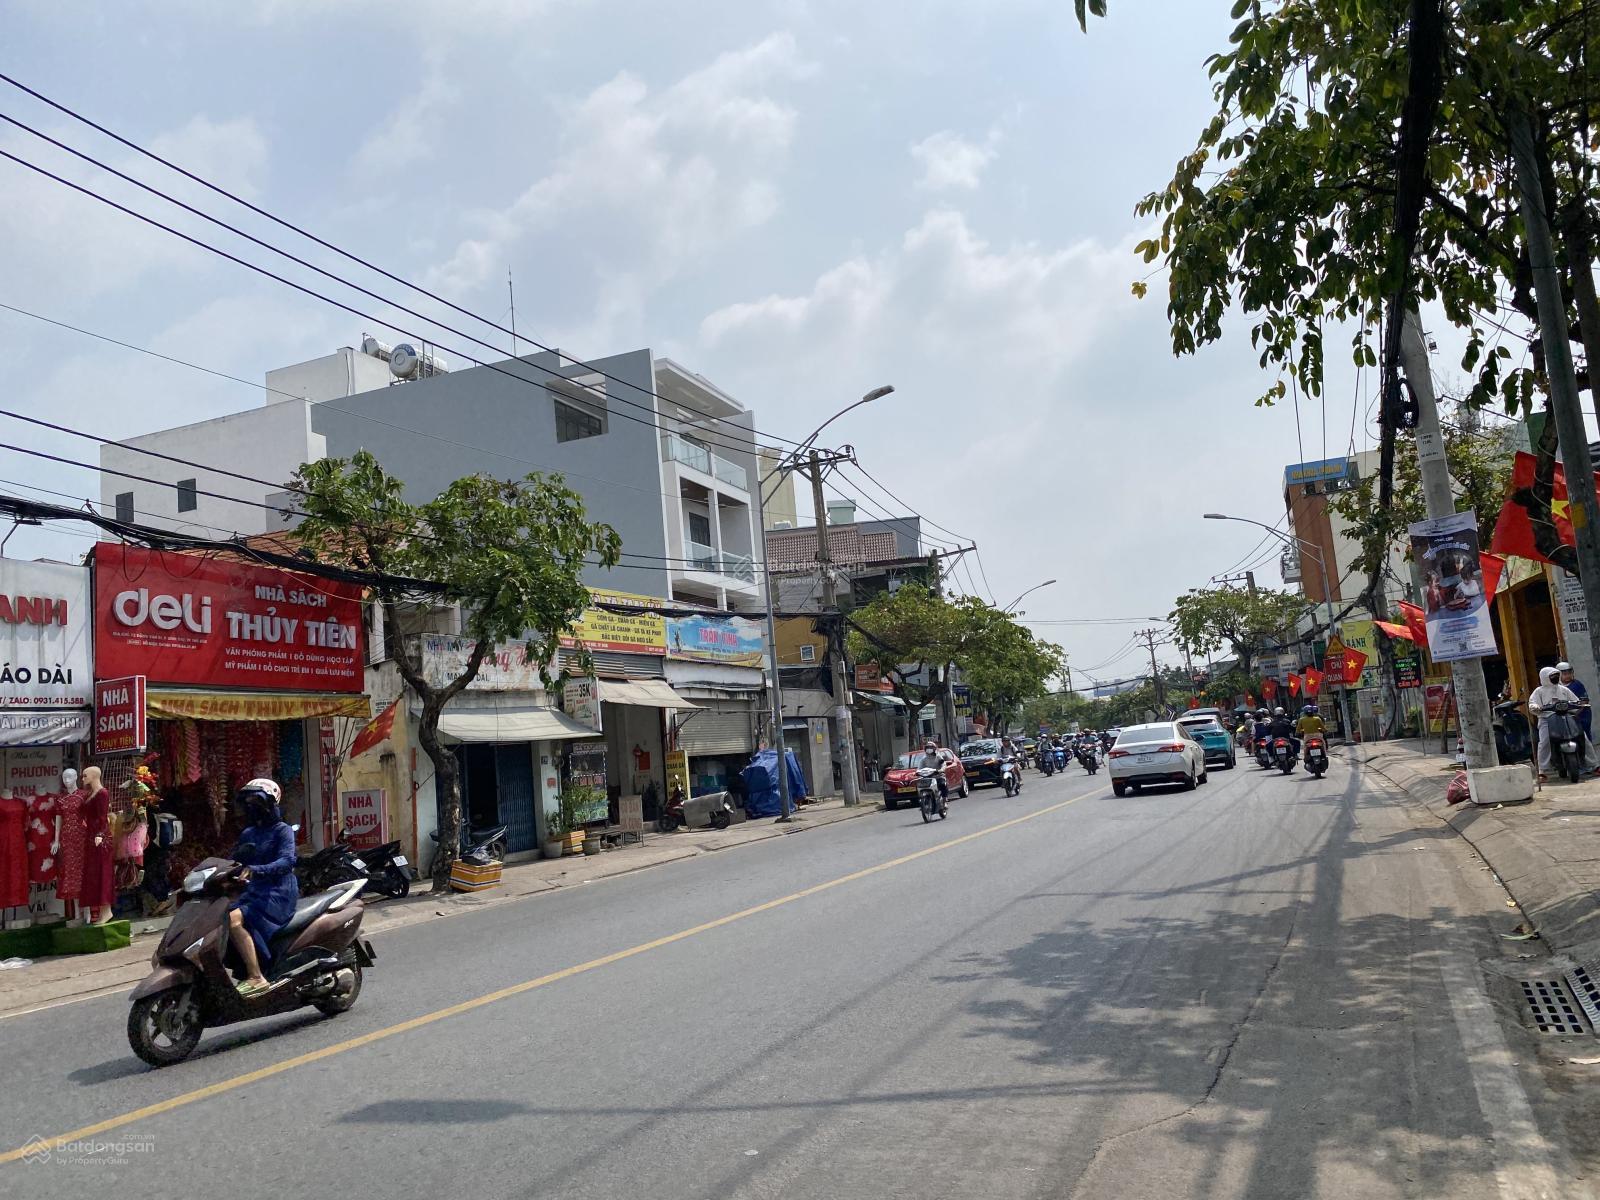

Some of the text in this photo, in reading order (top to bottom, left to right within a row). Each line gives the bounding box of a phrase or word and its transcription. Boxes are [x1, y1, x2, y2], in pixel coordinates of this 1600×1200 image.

[255, 585, 327, 607] NHÀ SÁCH
[113, 587, 212, 633] deli
[225, 606, 357, 649] THỦY TIÊN
[225, 647, 241, 656] VĂN
[242, 648, 267, 657] PHÒNG
[0, 662, 72, 685] ÁO DÀI
[102, 684, 129, 707] NHÀ
[579, 683, 591, 698] 35K
[200, 697, 240, 716] SÁCH
[99, 711, 133, 733] SÁCH
[348, 793, 373, 809] NHÀ
[346, 812, 377, 828] SÁCH
